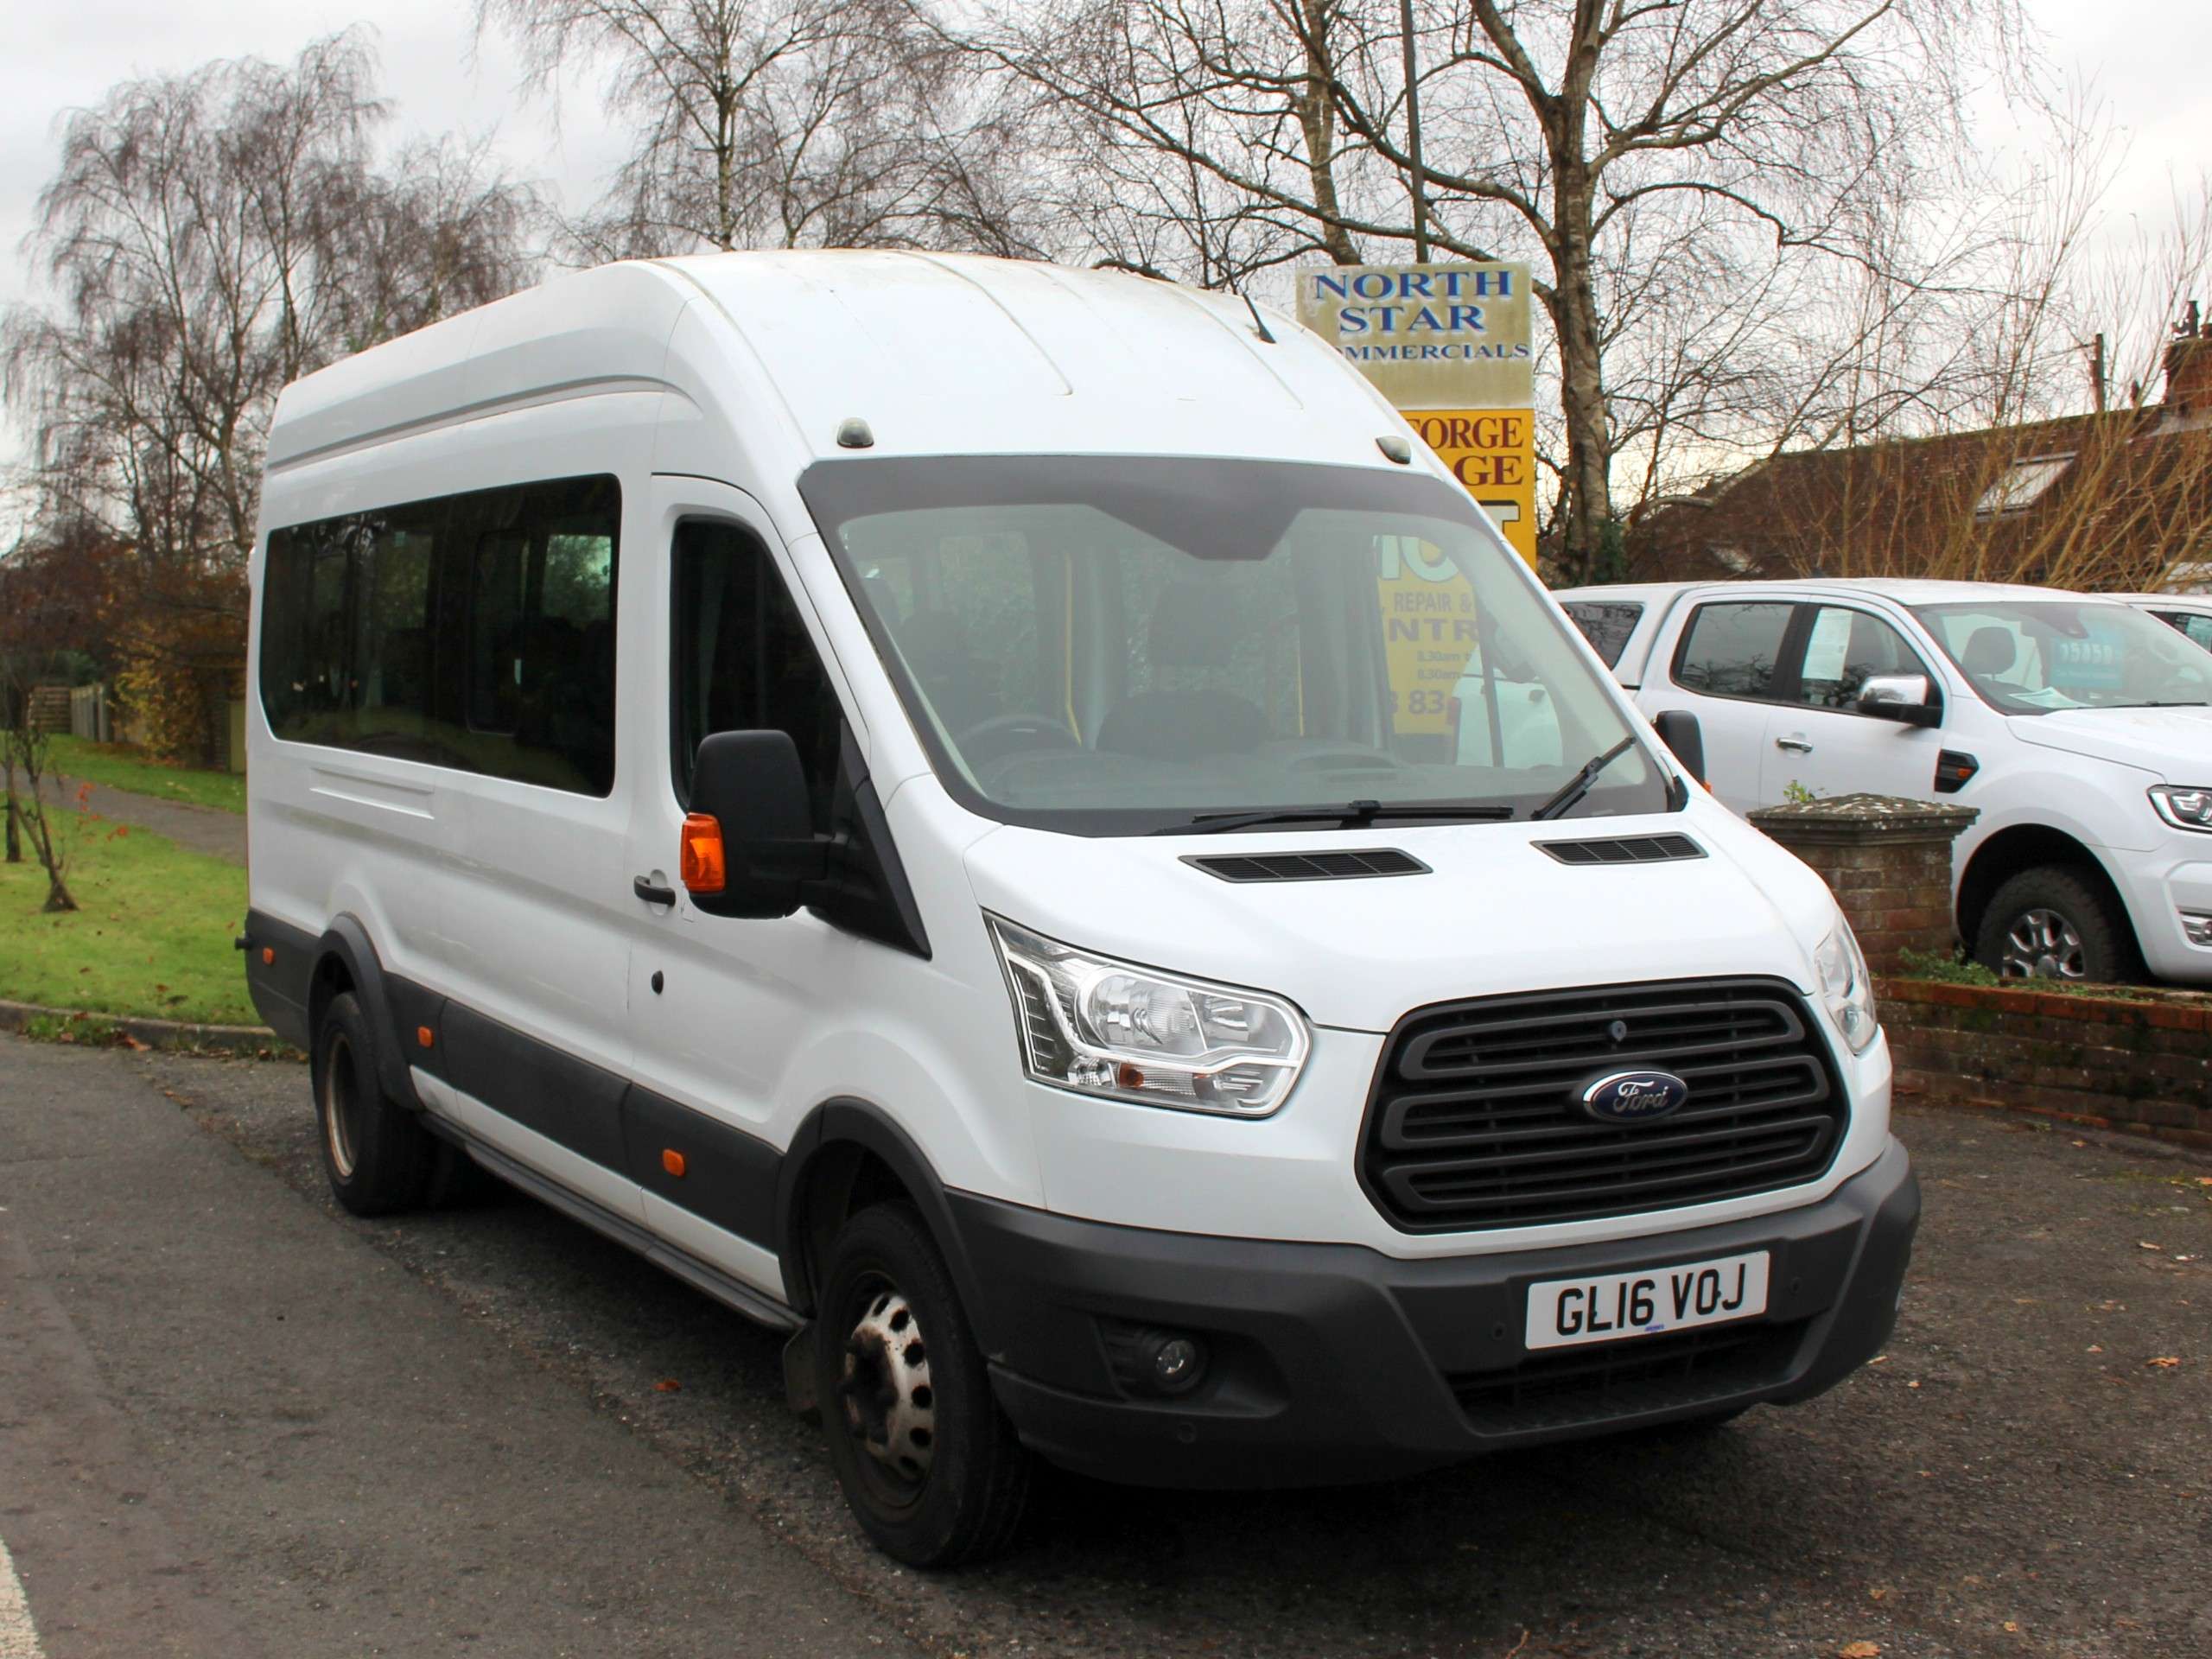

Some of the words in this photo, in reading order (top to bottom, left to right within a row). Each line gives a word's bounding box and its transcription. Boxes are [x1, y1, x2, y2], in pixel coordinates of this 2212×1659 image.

[1314, 270, 1511, 299] NORTH
[1339, 304, 1485, 334] STAR
[1394, 592, 1452, 612] REPAIR
[1612, 1081, 1669, 1113] Ford
[1556, 1279, 1656, 1337] GL16
[1671, 1262, 1746, 1319] VOJ
